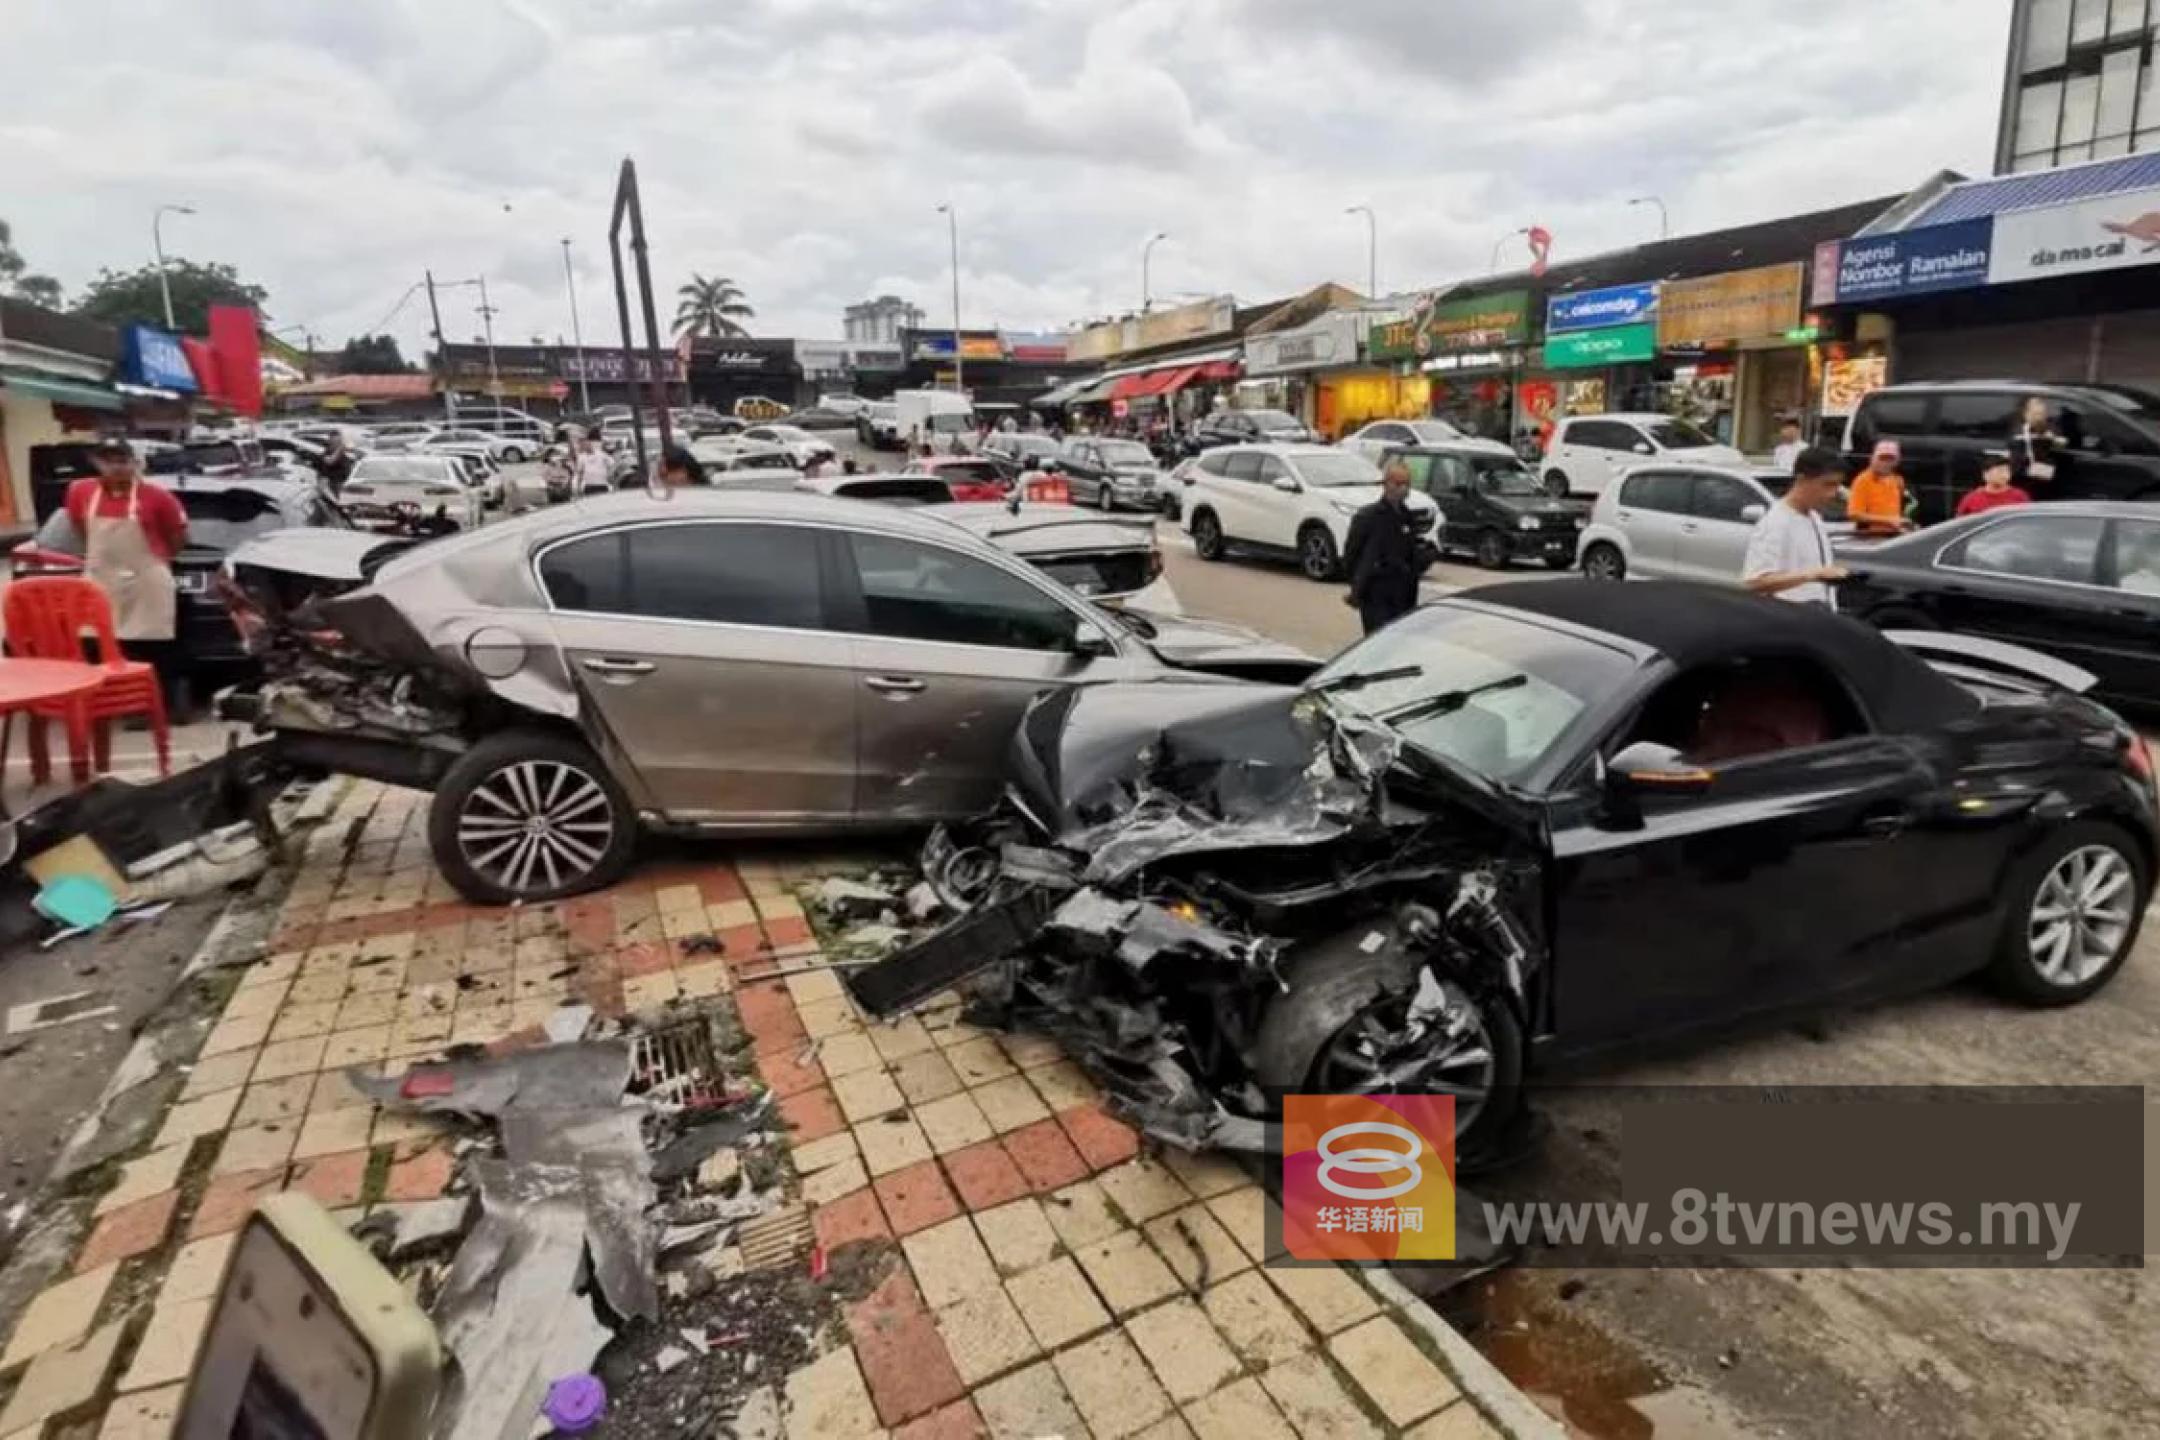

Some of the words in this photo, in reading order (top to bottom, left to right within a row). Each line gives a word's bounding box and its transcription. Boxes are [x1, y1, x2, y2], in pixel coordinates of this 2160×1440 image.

[1843, 240, 1896, 267] Agensi
[1910, 249, 1986, 274] Ramalan
[1841, 262, 1904, 284] Nombor
